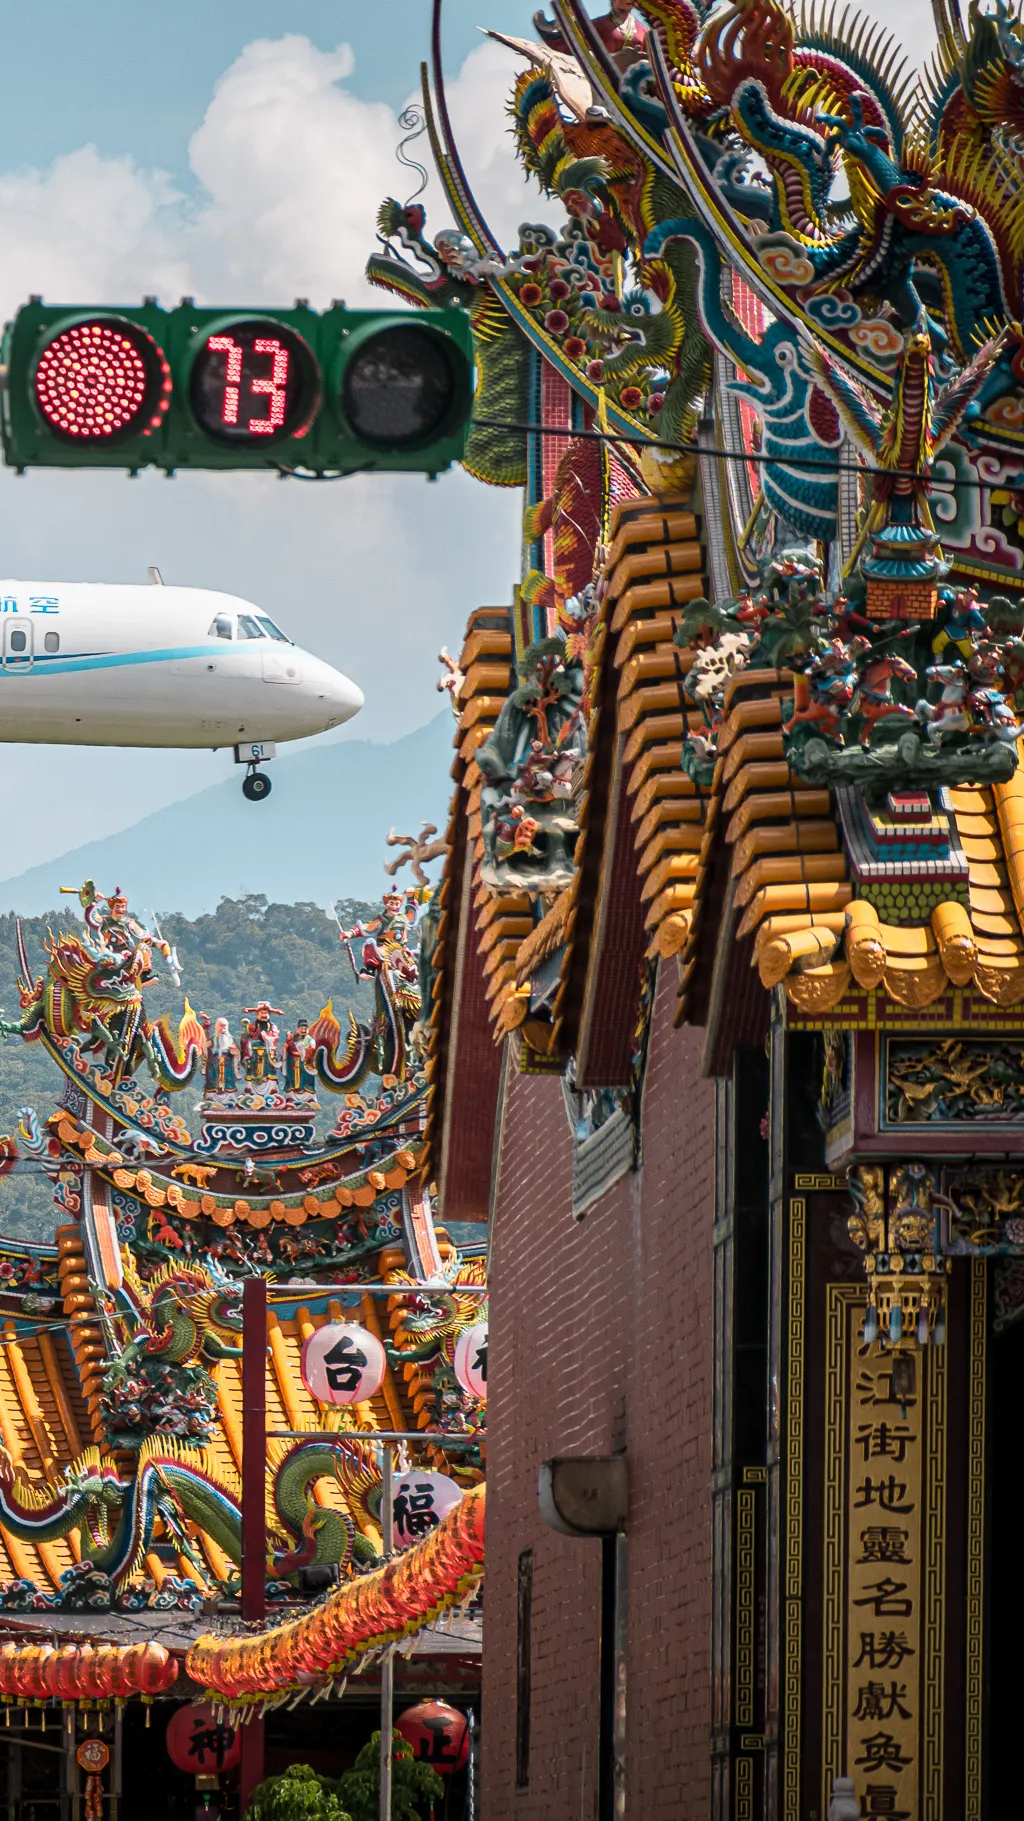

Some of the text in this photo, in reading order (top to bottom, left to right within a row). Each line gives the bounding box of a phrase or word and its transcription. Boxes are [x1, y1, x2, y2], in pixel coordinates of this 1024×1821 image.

[207, 335, 288, 434] 73
[251, 744, 264, 757] 61
[322, 1335, 368, 1392] 台
[392, 1483, 441, 1537] 福
[188, 1718, 236, 1770] 神
[413, 1716, 459, 1764] 正
